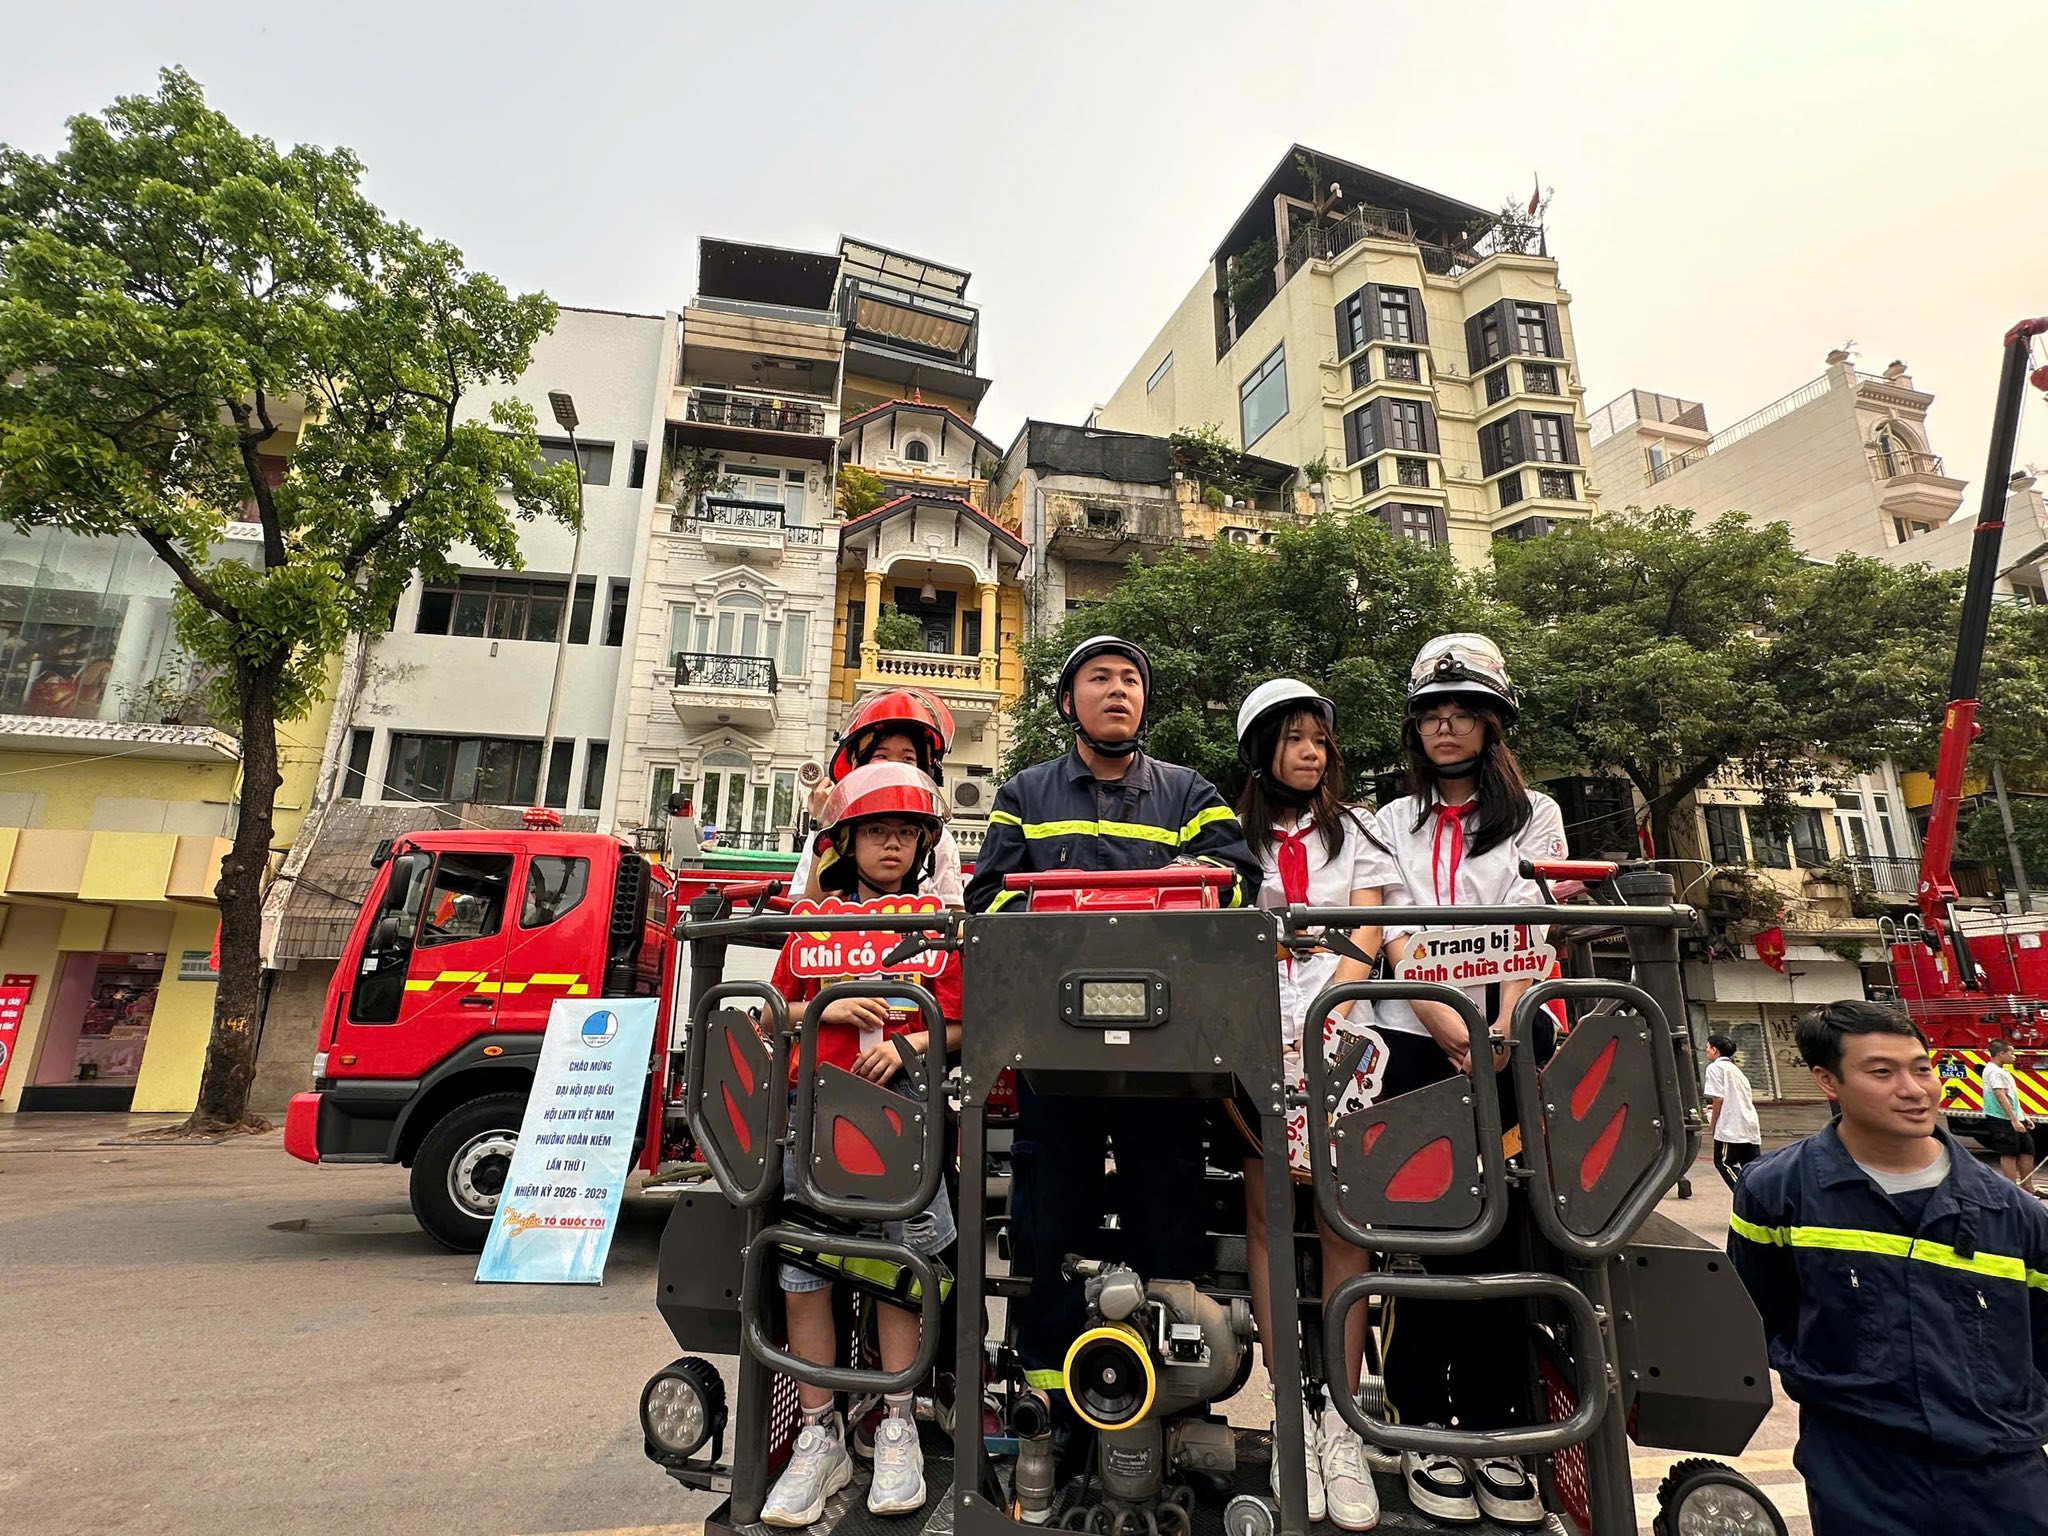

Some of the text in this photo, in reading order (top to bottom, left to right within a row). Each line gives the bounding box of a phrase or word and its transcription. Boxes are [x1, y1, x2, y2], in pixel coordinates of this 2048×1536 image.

[1427, 928, 1509, 957] Trang bị
[800, 943, 842, 968] Khi
[847, 941, 876, 966] có
[1452, 957, 1499, 980] chữa
[1502, 950, 1547, 973] cháy
[569, 1060, 612, 1071] CHÀO MỪNG
[555, 1085, 569, 1097] ĐẠI
[569, 1083, 583, 1097] HỘI
[583, 1085, 596, 1097] ĐẠI
[544, 1107, 615, 1122] HỘI LHTN VIỆT NAM
[566, 1132, 588, 1146] HOÀN
[589, 1133, 612, 1146] KIẾM
[581, 1161, 586, 1172] I
[514, 1184, 540, 1199] NHIỆM
[553, 1186, 577, 1198] 2026
[584, 1187, 608, 1199] 2029
